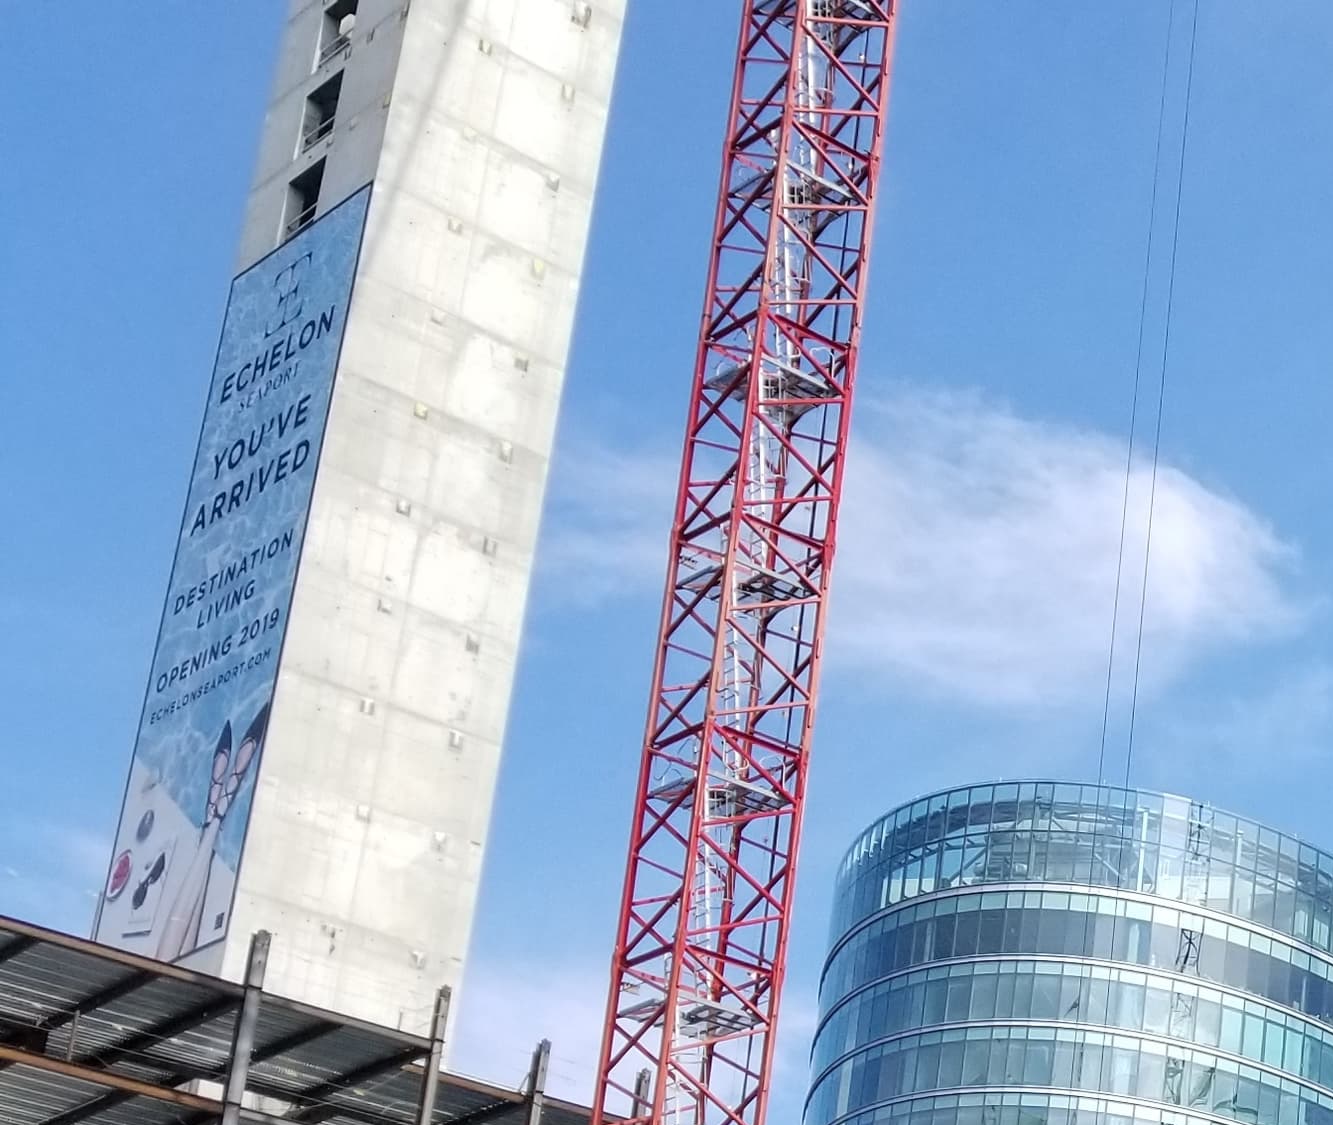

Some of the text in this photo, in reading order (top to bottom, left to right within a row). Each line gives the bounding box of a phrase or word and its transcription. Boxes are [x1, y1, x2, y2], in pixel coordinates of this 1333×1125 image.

[220, 304, 336, 405] ECHELON
[238, 361, 301, 413] SEAPORT
[214, 394, 312, 480] YOU'VE
[190, 439, 311, 537] ARRIVED
[174, 528, 294, 616] DESTINATION
[196, 579, 256, 630] LIVING
[150, 647, 272, 725] ECHELONSEAPORT.COM
[156, 607, 280, 693] OPENING 2019
